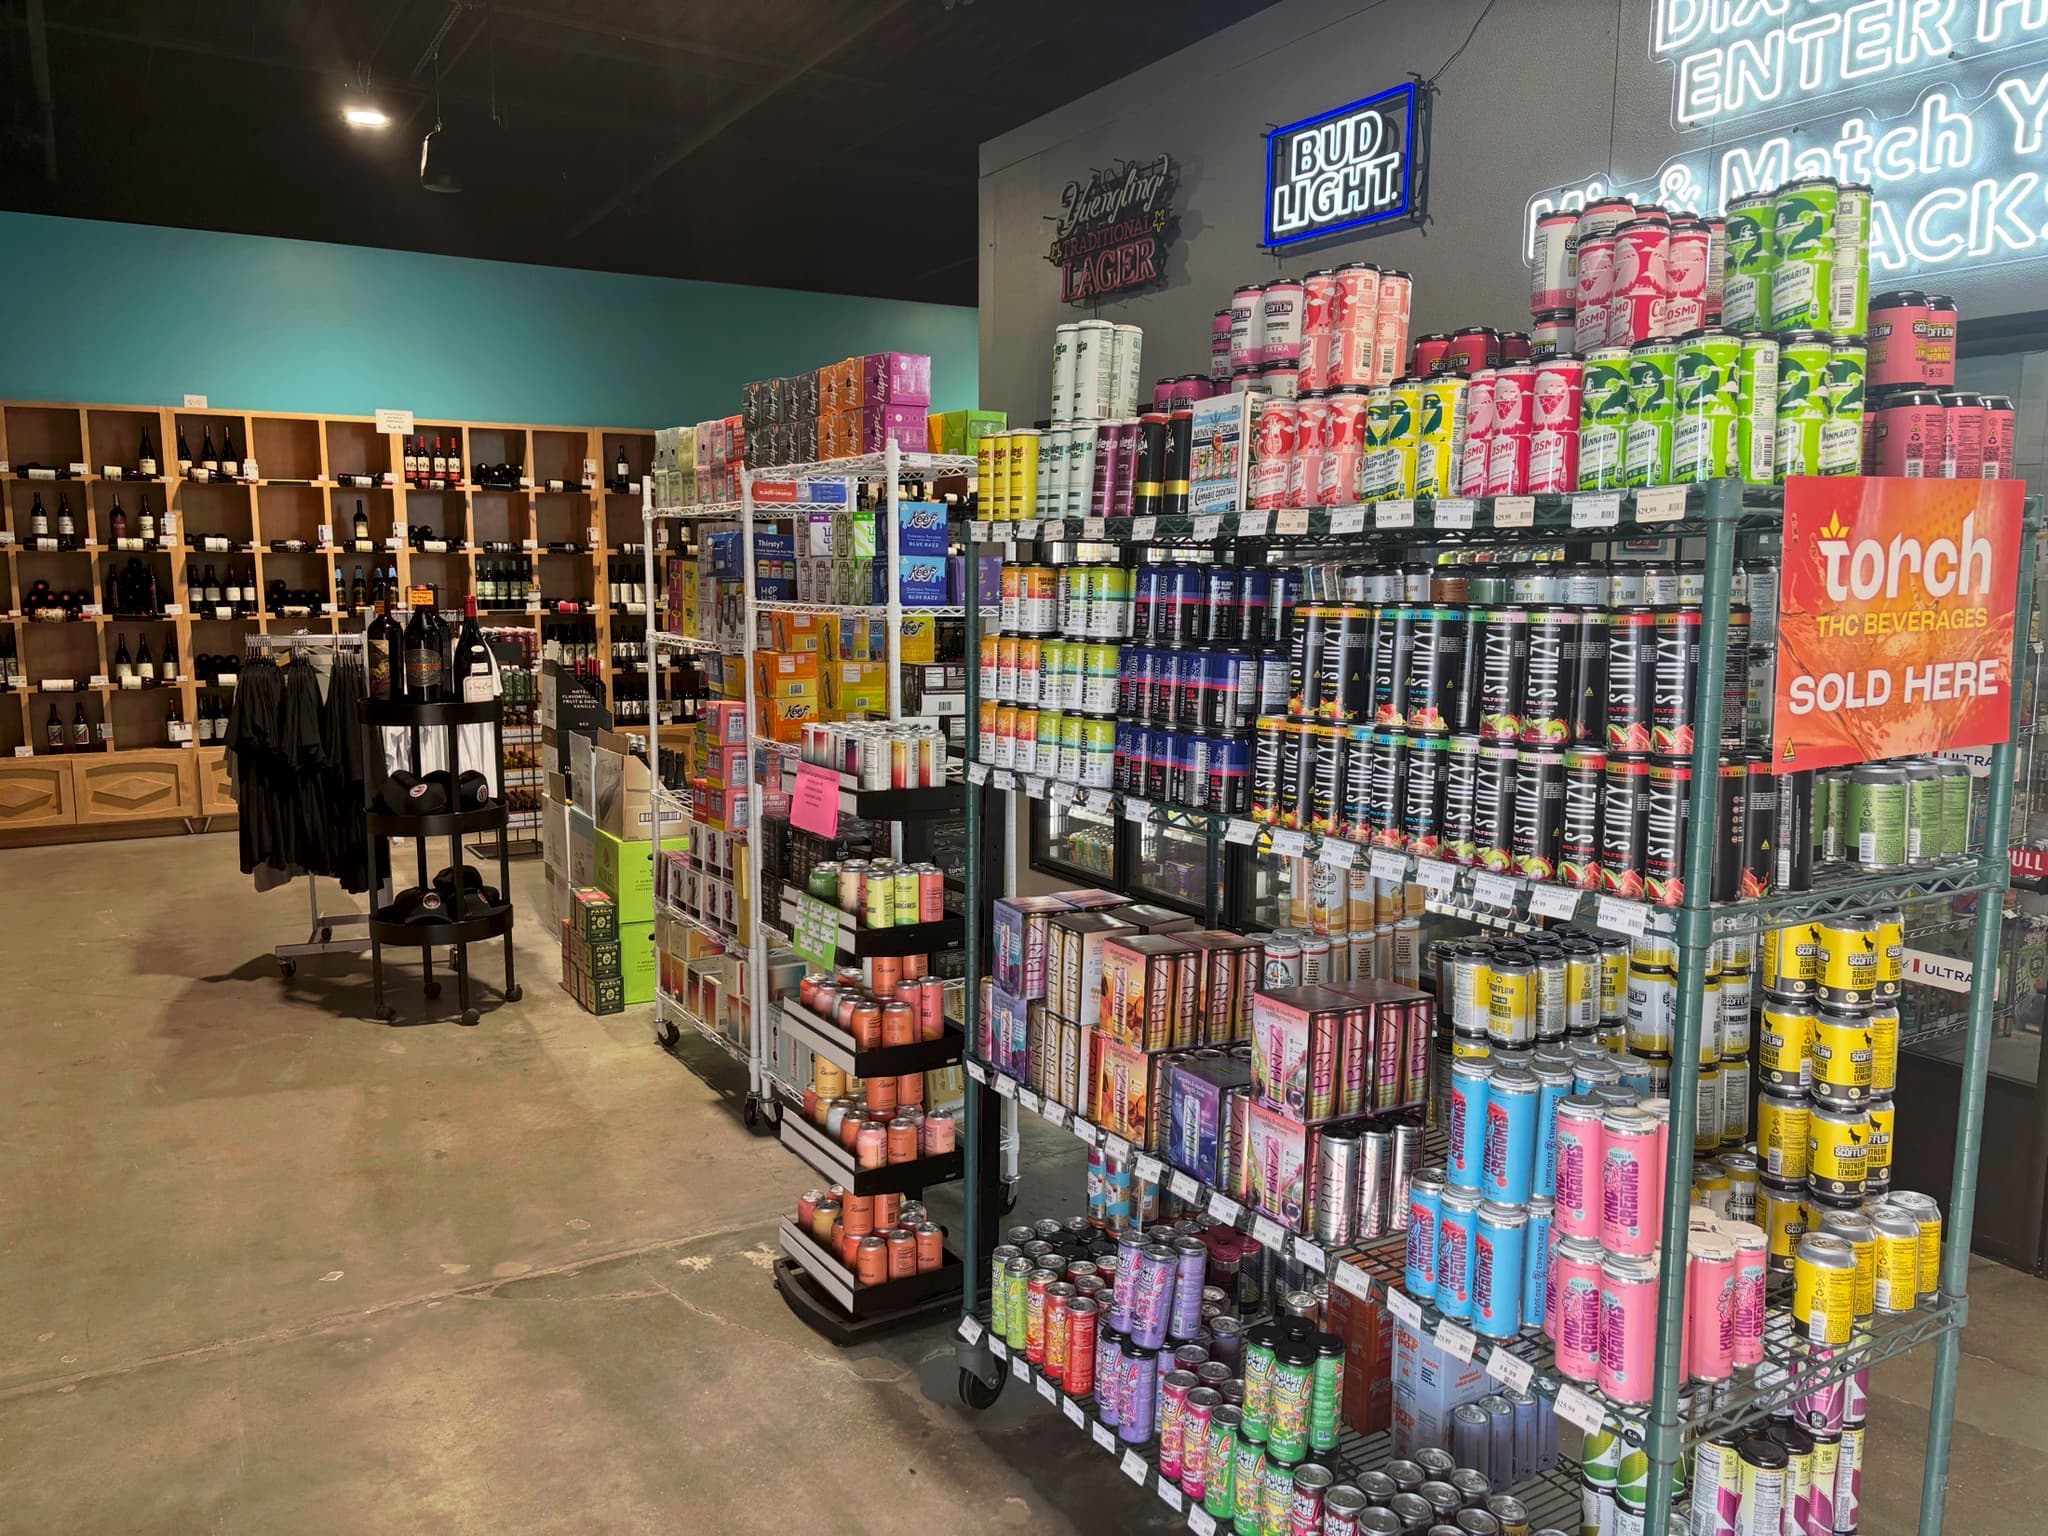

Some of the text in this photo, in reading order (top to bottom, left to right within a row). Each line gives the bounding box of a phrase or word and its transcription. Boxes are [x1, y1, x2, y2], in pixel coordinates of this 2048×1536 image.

[1677, 0, 1955, 123] ENTER
[1291, 110, 1383, 181] BUD
[1721, 93, 1975, 216] Match
[1057, 153, 1168, 239] Yuengling
[1063, 214, 1152, 259] TRADITIONAL
[1061, 238, 1157, 303] LAGER
[758, 539, 784, 549] Thirsty?
[1817, 510, 1992, 602] torch
[1816, 607, 1988, 638] THC BEVERAGES
[1608, 638, 1637, 704] STIIIZY
[1655, 636, 1687, 705] STIIIZY
[1789, 659, 1999, 715] SOLD HERE
[1564, 778, 1597, 844] STIIIZY
[1603, 783, 1633, 850] STIIIZY
[1647, 789, 1677, 858] STIIIZY
[1923, 962, 1973, 984] ULTRA
[1566, 1143, 1583, 1210] CREATURES
[1604, 1159, 1639, 1228] KIND CREATURES
[1563, 1288, 1599, 1354] KIND CREATURES
[1608, 1304, 1625, 1372] CREATURES
[1735, 1306, 1749, 1338] KIND
